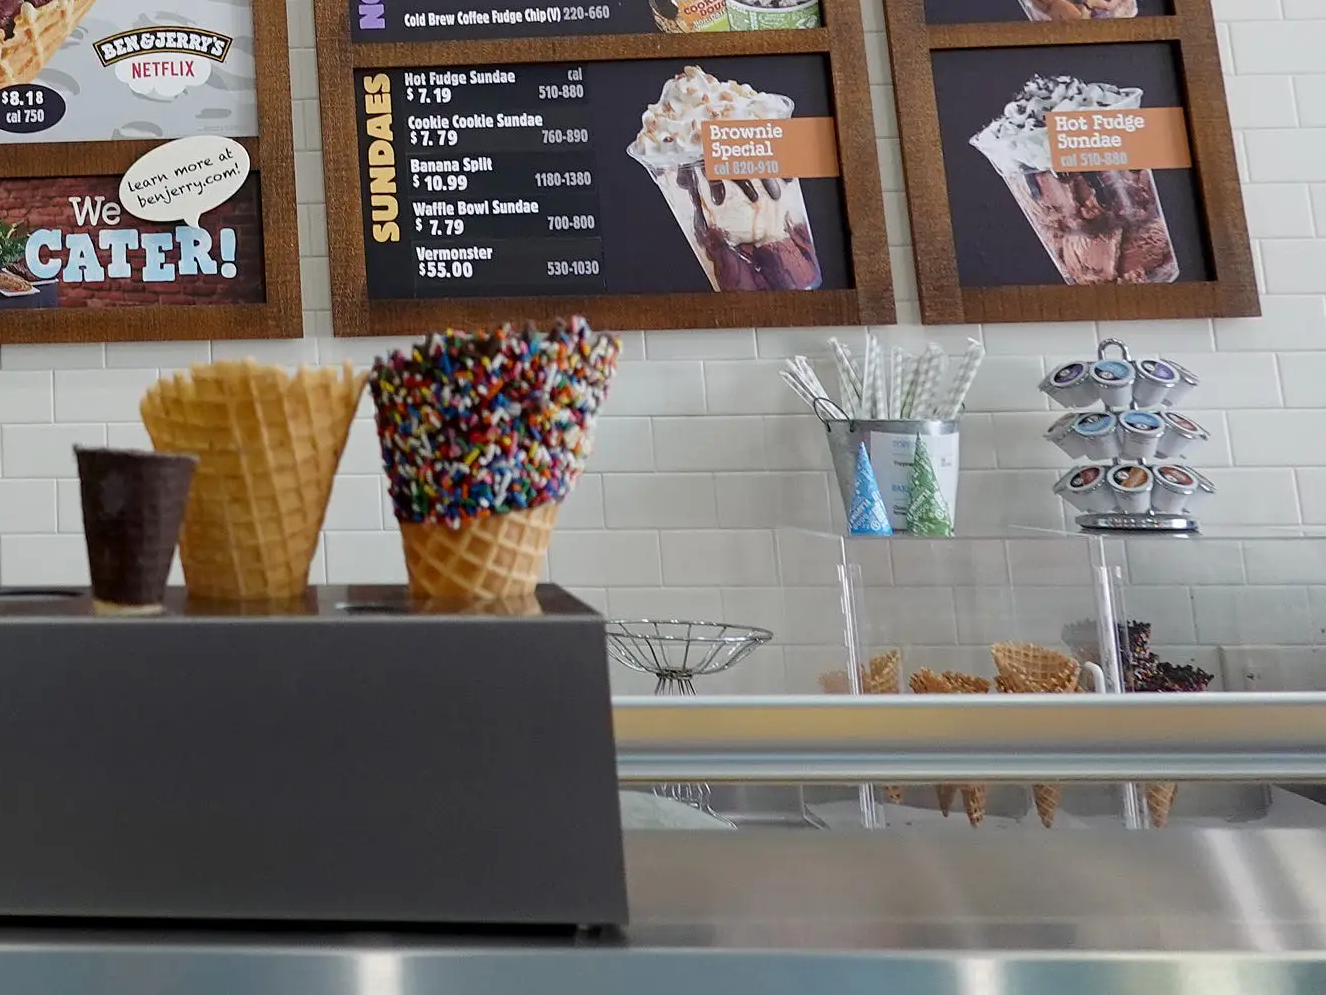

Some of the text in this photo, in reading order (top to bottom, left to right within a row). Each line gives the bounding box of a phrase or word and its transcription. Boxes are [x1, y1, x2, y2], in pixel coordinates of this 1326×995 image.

[132, 62, 194, 79] NETFLIX
[405, 70, 515, 86] Hot Fudge Sundae
[2, 91, 43, 106] $8.18
[6, 109, 44, 122] cal 750
[1055, 114, 1145, 132] Hot Fudge
[710, 123, 782, 140] Brownie
[1058, 133, 1122, 148] Sundae
[364, 72, 400, 243] SUNDAES
[712, 141, 773, 159] Special
[128, 147, 233, 193] learn more at
[138, 163, 240, 208] benjerry.com!
[69, 196, 120, 226] We
[25, 227, 237, 282] CATER!
[416, 247, 492, 260] Vermonster
[419, 261, 472, 277] $55.00
